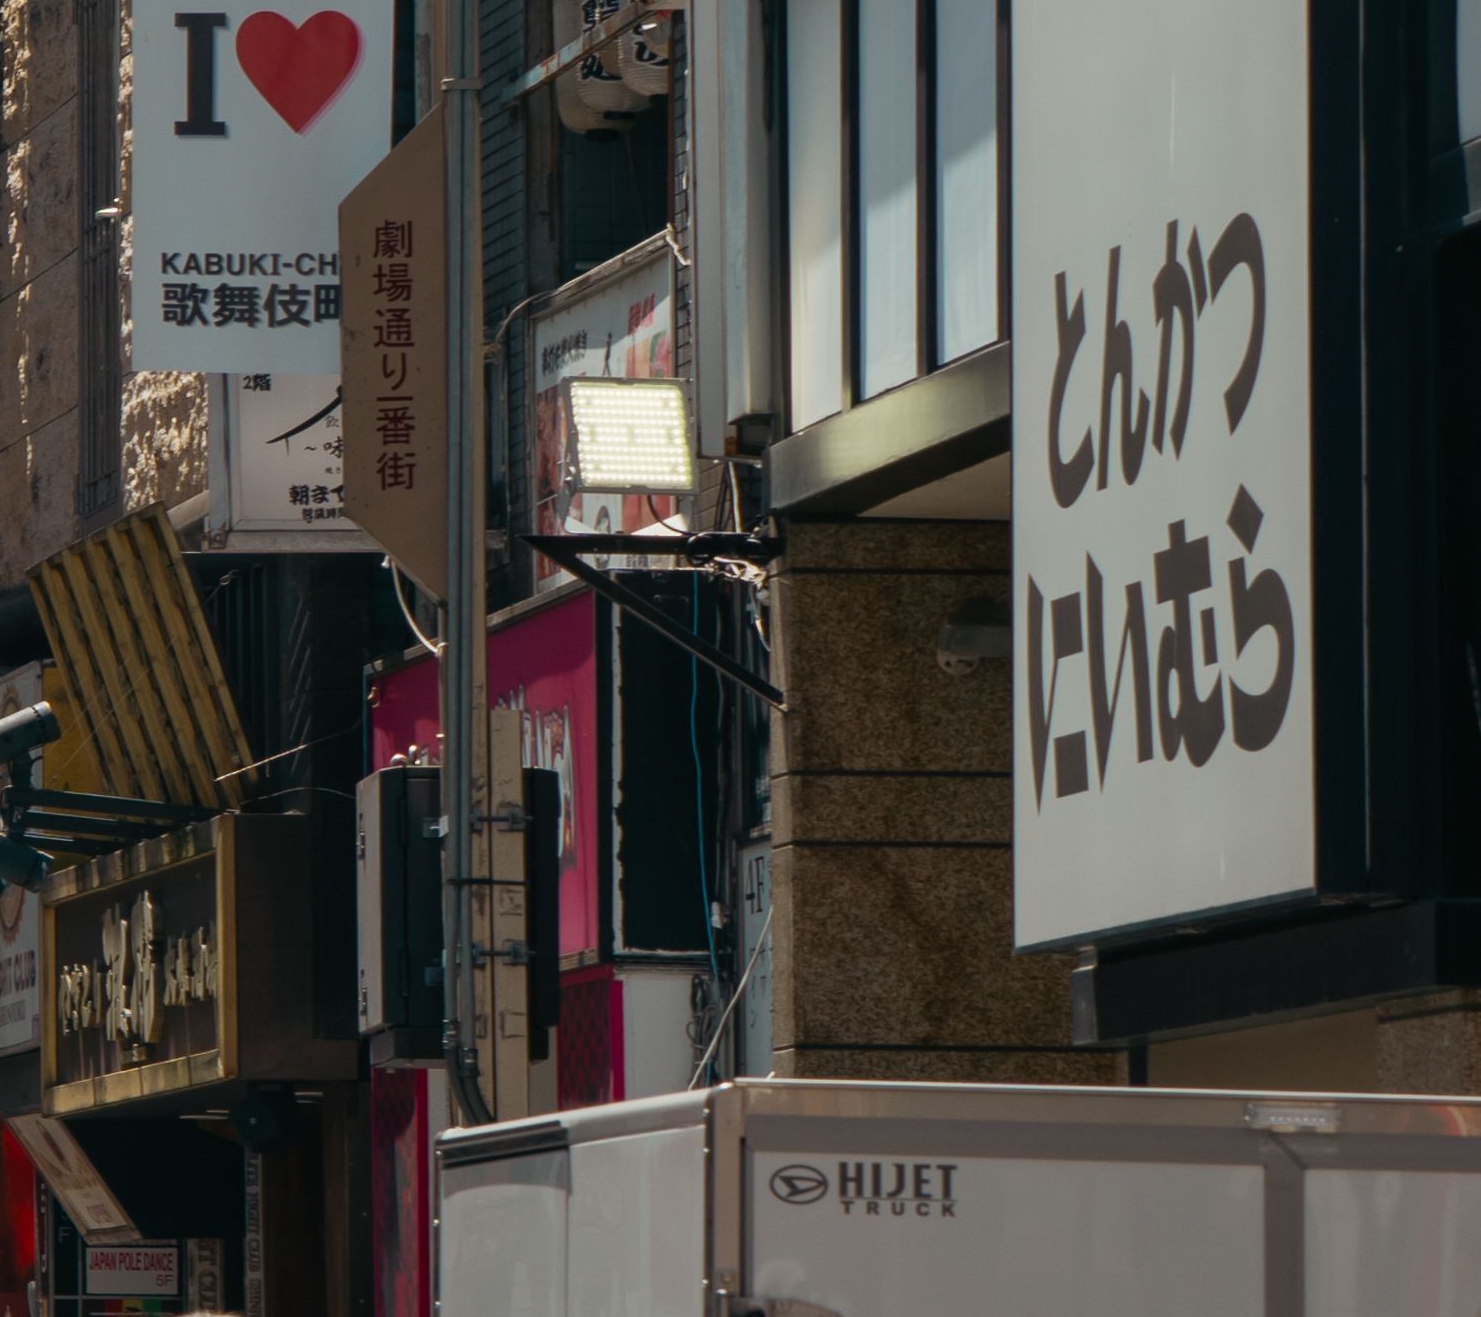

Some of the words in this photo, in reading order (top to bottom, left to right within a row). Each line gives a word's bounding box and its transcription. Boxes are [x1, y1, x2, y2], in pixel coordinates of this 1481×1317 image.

[174, 12, 227, 136] I
[373, 219, 417, 491] 劇場通り一番街
[1047, 212, 1266, 509] とんかつ
[1026, 484, 1296, 814] にいむら
[839, 1162, 959, 1202] HIJET
[842, 1200, 957, 1217] TRUCK
